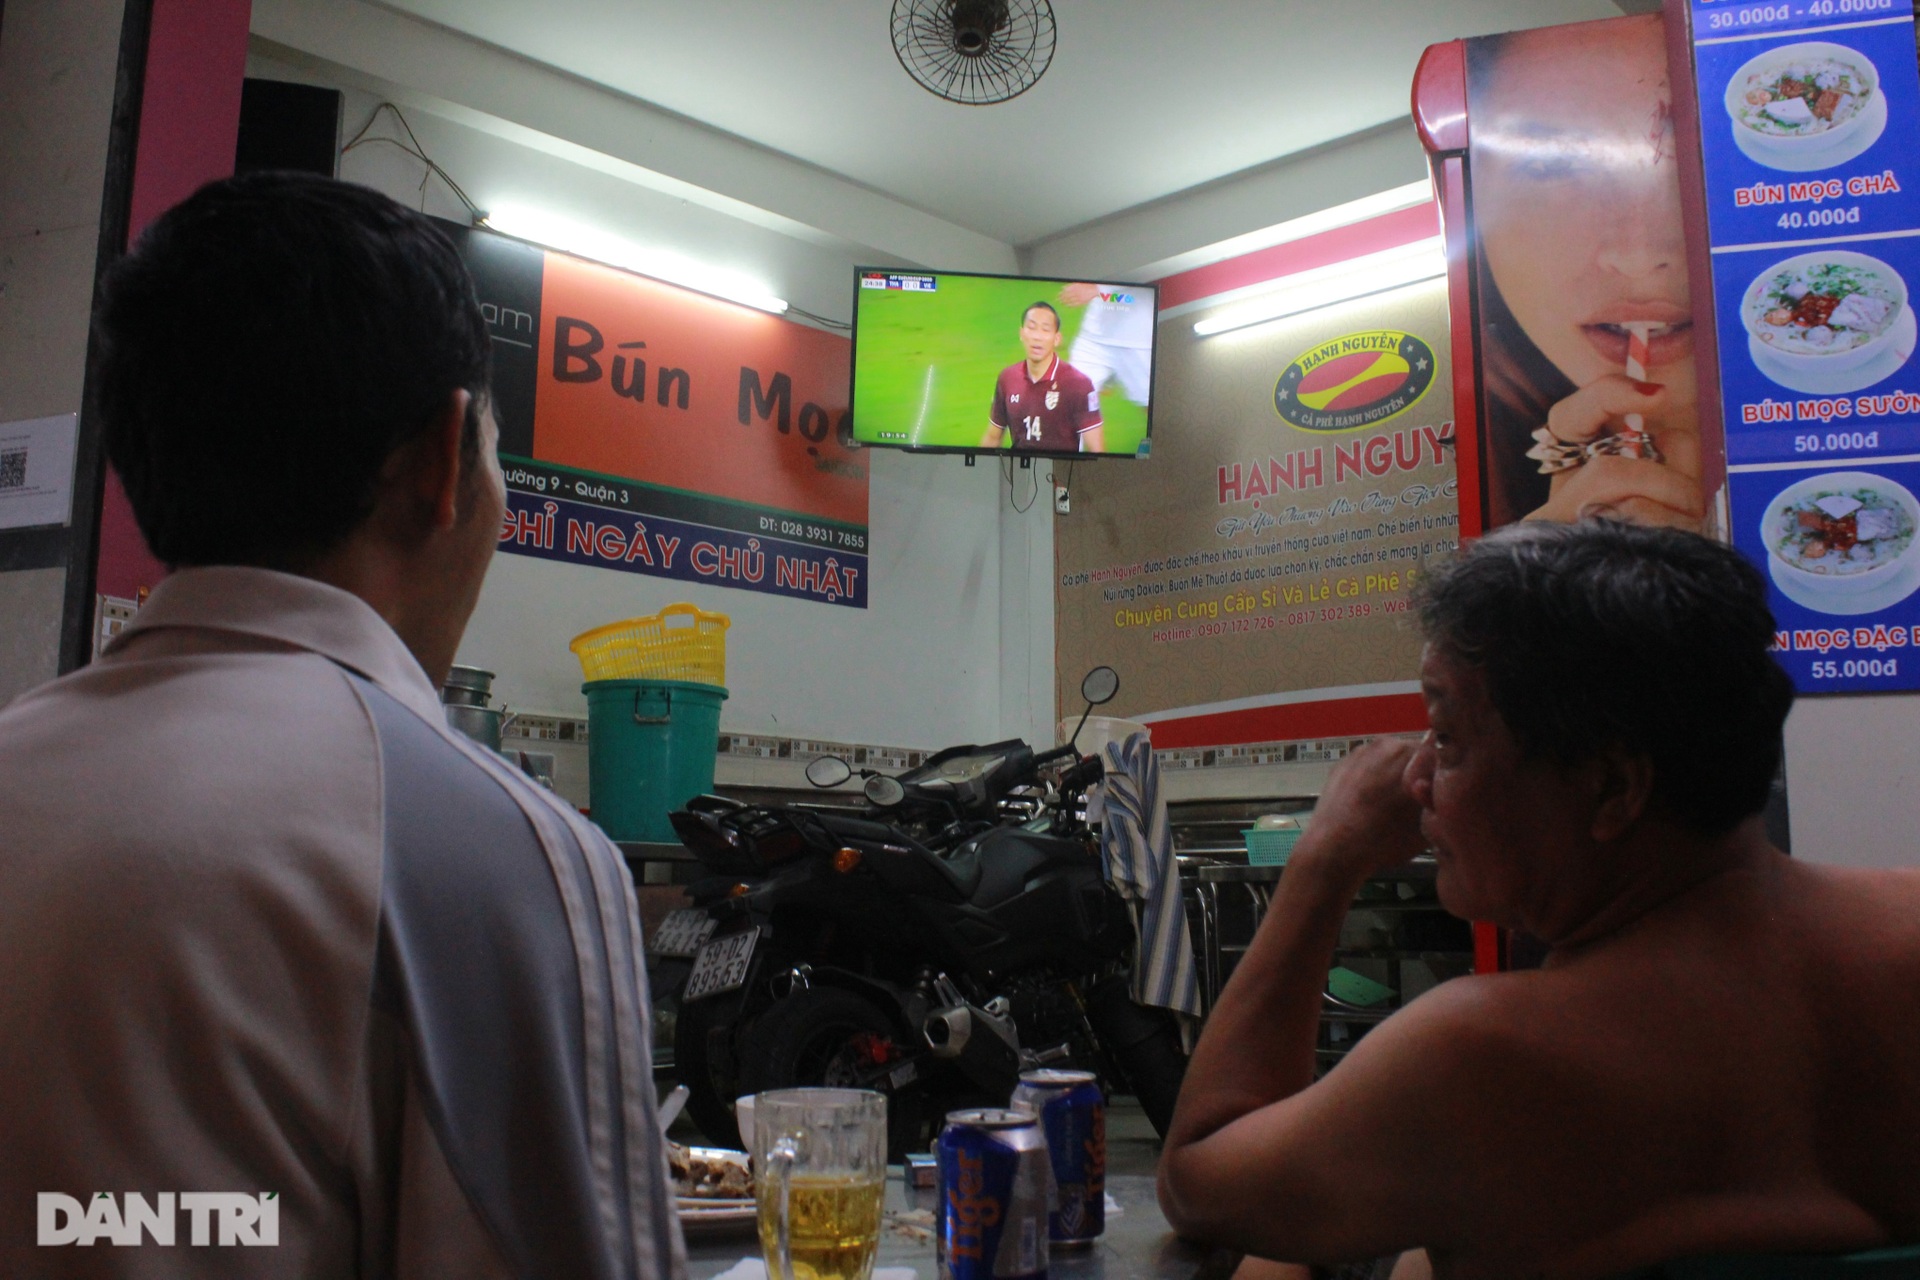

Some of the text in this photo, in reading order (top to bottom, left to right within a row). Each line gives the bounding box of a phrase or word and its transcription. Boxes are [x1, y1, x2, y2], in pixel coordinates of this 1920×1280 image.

[1709, 4, 1790, 30] 30.000đ
[1735, 182, 1784, 207] BÚN
[1789, 179, 1843, 203] MỌC
[1777, 207, 1860, 229] 40.000đ
[552, 315, 691, 411] Bún
[1302, 332, 1398, 370] HẠNH NGUYÊN
[1315, 412, 1333, 427] PHÊ
[1335, 414, 1364, 428] HẠNH
[1364, 396, 1405, 422] NGUYÊN
[1742, 398, 1793, 424] BÚN
[1797, 398, 1852, 423] MỌC
[1023, 415, 1042, 441] 14
[1794, 431, 1879, 453] 50.000đ
[551, 476, 560, 490] 9
[575, 481, 617, 503] Quận
[620, 490, 629, 504] 3
[1217, 446, 1325, 510] HẠNH
[759, 516, 864, 549] ĐT: 028 3931 7855
[567, 516, 680, 569] NGÀY
[690, 537, 765, 584] CHỦ
[775, 554, 858, 602] NHẬT
[1091, 569, 1111, 584] Hạnh
[1201, 551, 1220, 564] theo
[1351, 528, 1374, 541] nam.
[1399, 514, 1420, 533] biến
[1284, 561, 1307, 577] chọn
[1390, 545, 1418, 560] mang
[1420, 541, 1433, 559] lại
[1115, 604, 1172, 627] Chuyên
[1177, 600, 1218, 619] Cung
[1223, 589, 1256, 614] Cấp
[1262, 585, 1277, 608] Sỉ
[1283, 585, 1303, 605] Và
[1310, 578, 1330, 602] Lẻ
[1336, 577, 1359, 598] Cà
[1365, 571, 1399, 594] Phê
[1153, 627, 1195, 642] Hotline:
[1198, 621, 1227, 636] 0907
[1231, 619, 1249, 632] 172
[1254, 616, 1275, 629] 726
[1288, 611, 1316, 626] 0817
[1321, 607, 1343, 622] 302
[1348, 604, 1371, 619] 389
[1794, 629, 1850, 654] MỌC
[1853, 624, 1908, 651] ĐẶC
[1811, 659, 1897, 678] 55.000đ
[948, 1148, 1000, 1265] Tiger
